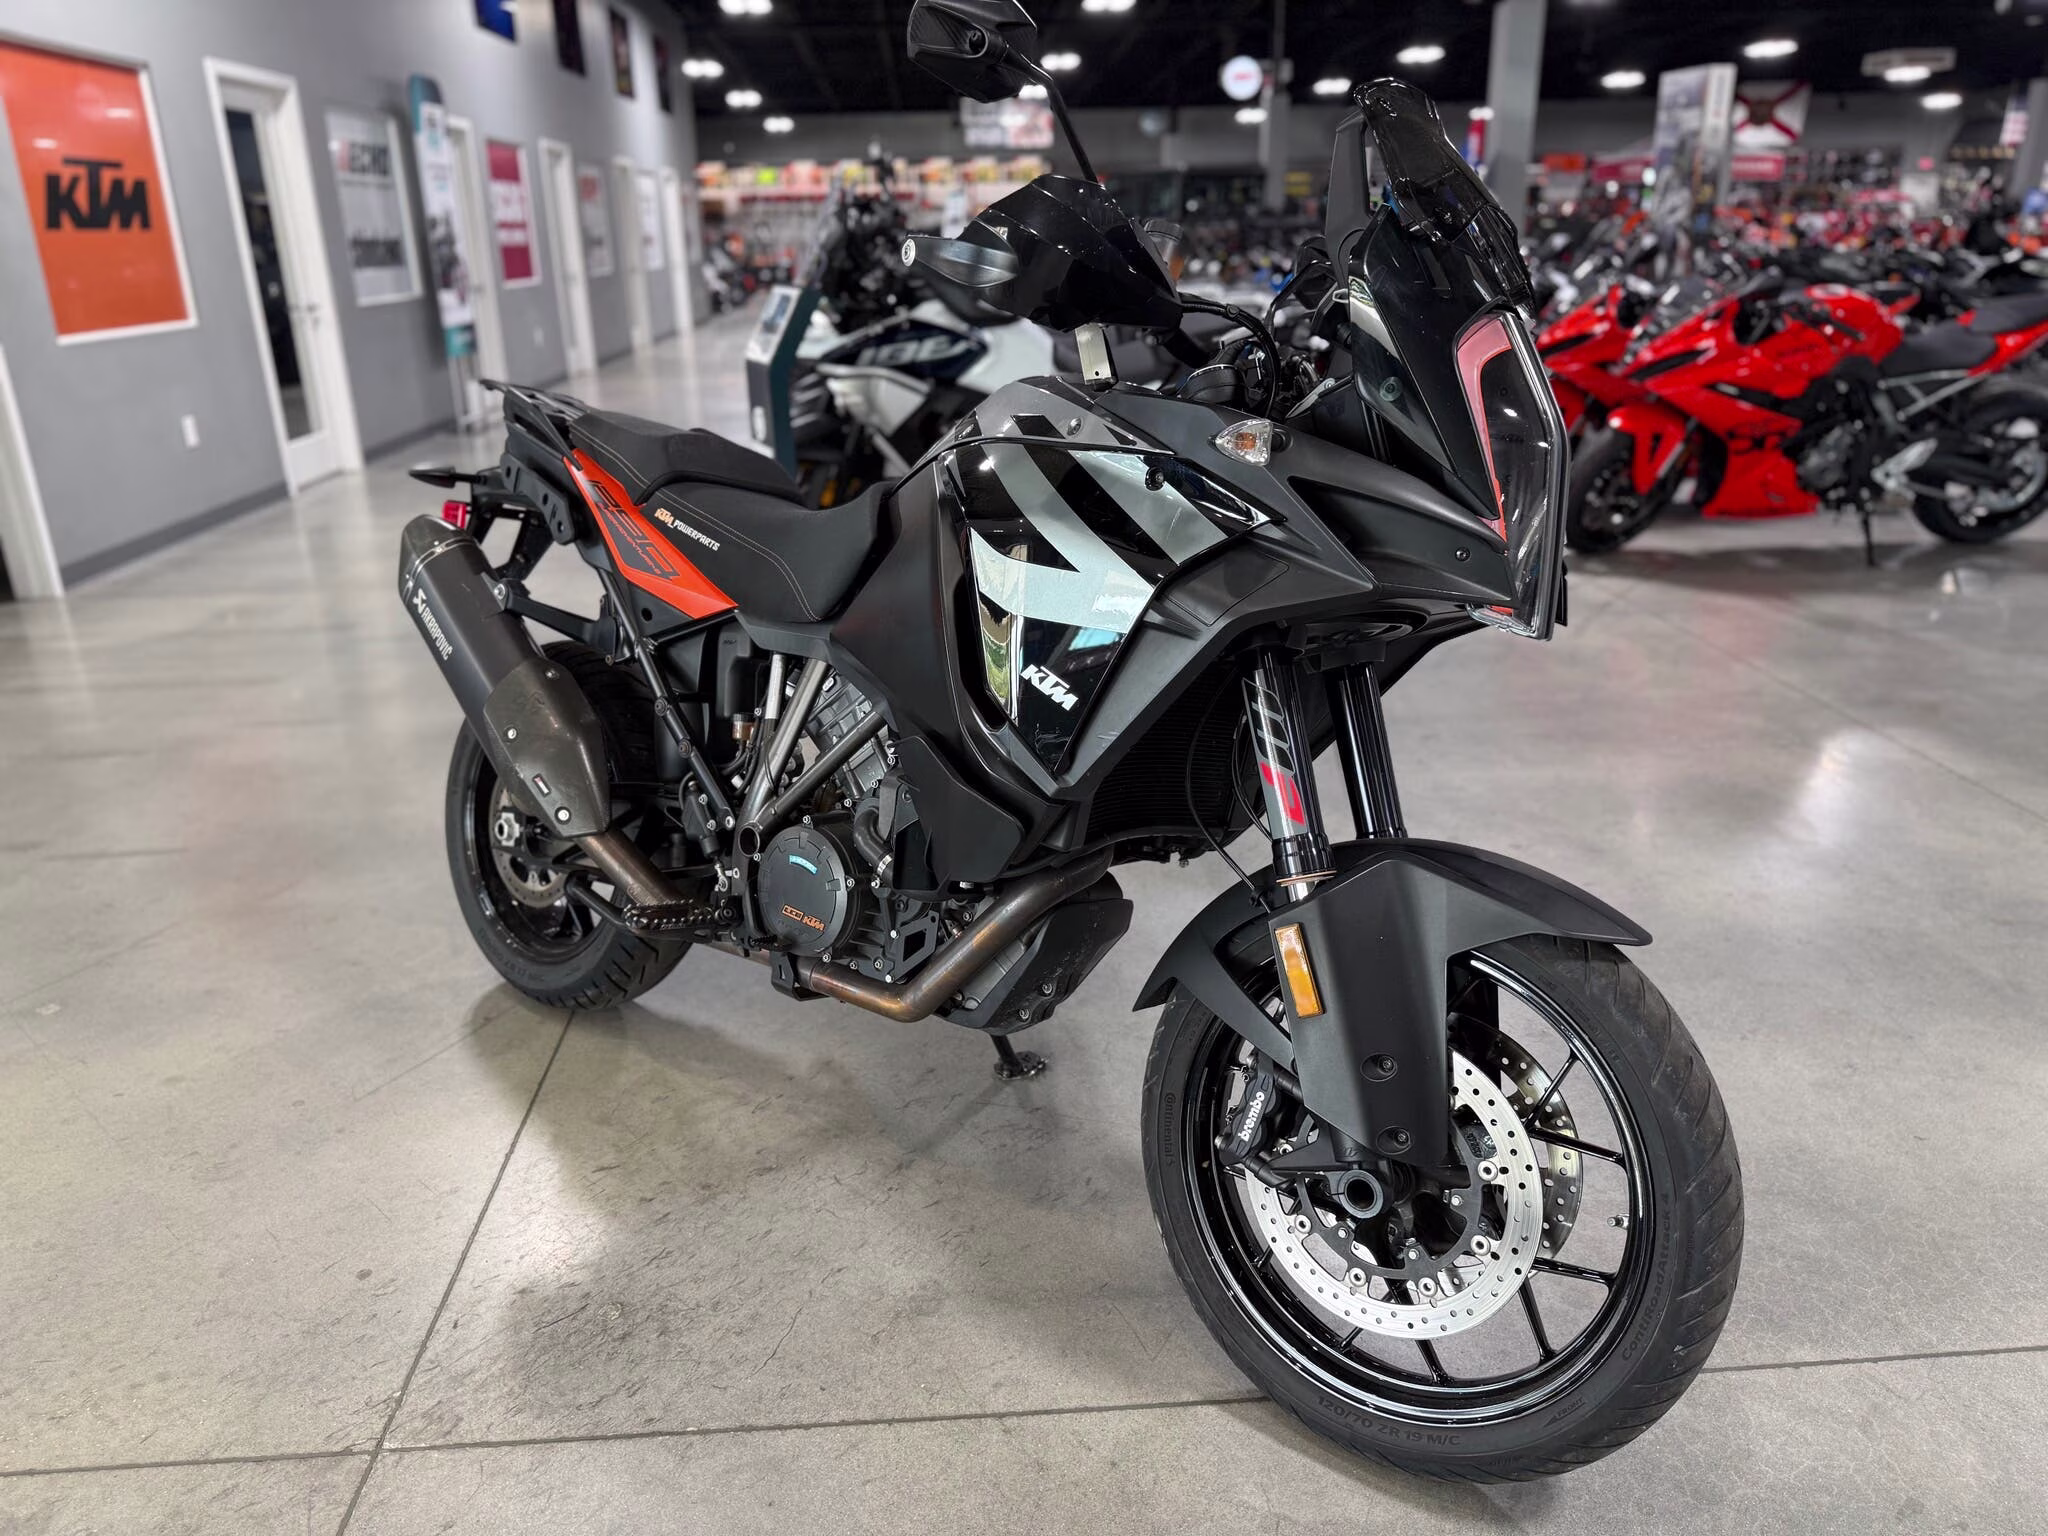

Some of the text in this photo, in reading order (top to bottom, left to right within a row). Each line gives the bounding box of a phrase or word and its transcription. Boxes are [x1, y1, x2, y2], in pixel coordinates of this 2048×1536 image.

[45, 156, 152, 230] KTM
[673, 520, 720, 551] POWERPARTS
[1020, 664, 1079, 711] KTM
[803, 915, 825, 931] KTM
[1164, 1092, 1177, 1158] Continental
[1238, 1092, 1265, 1142] brembo
[1621, 1208, 1672, 1361] ContiRoadAttack
[1317, 1396, 1461, 1446] 120/70 ZR 19 M/C
